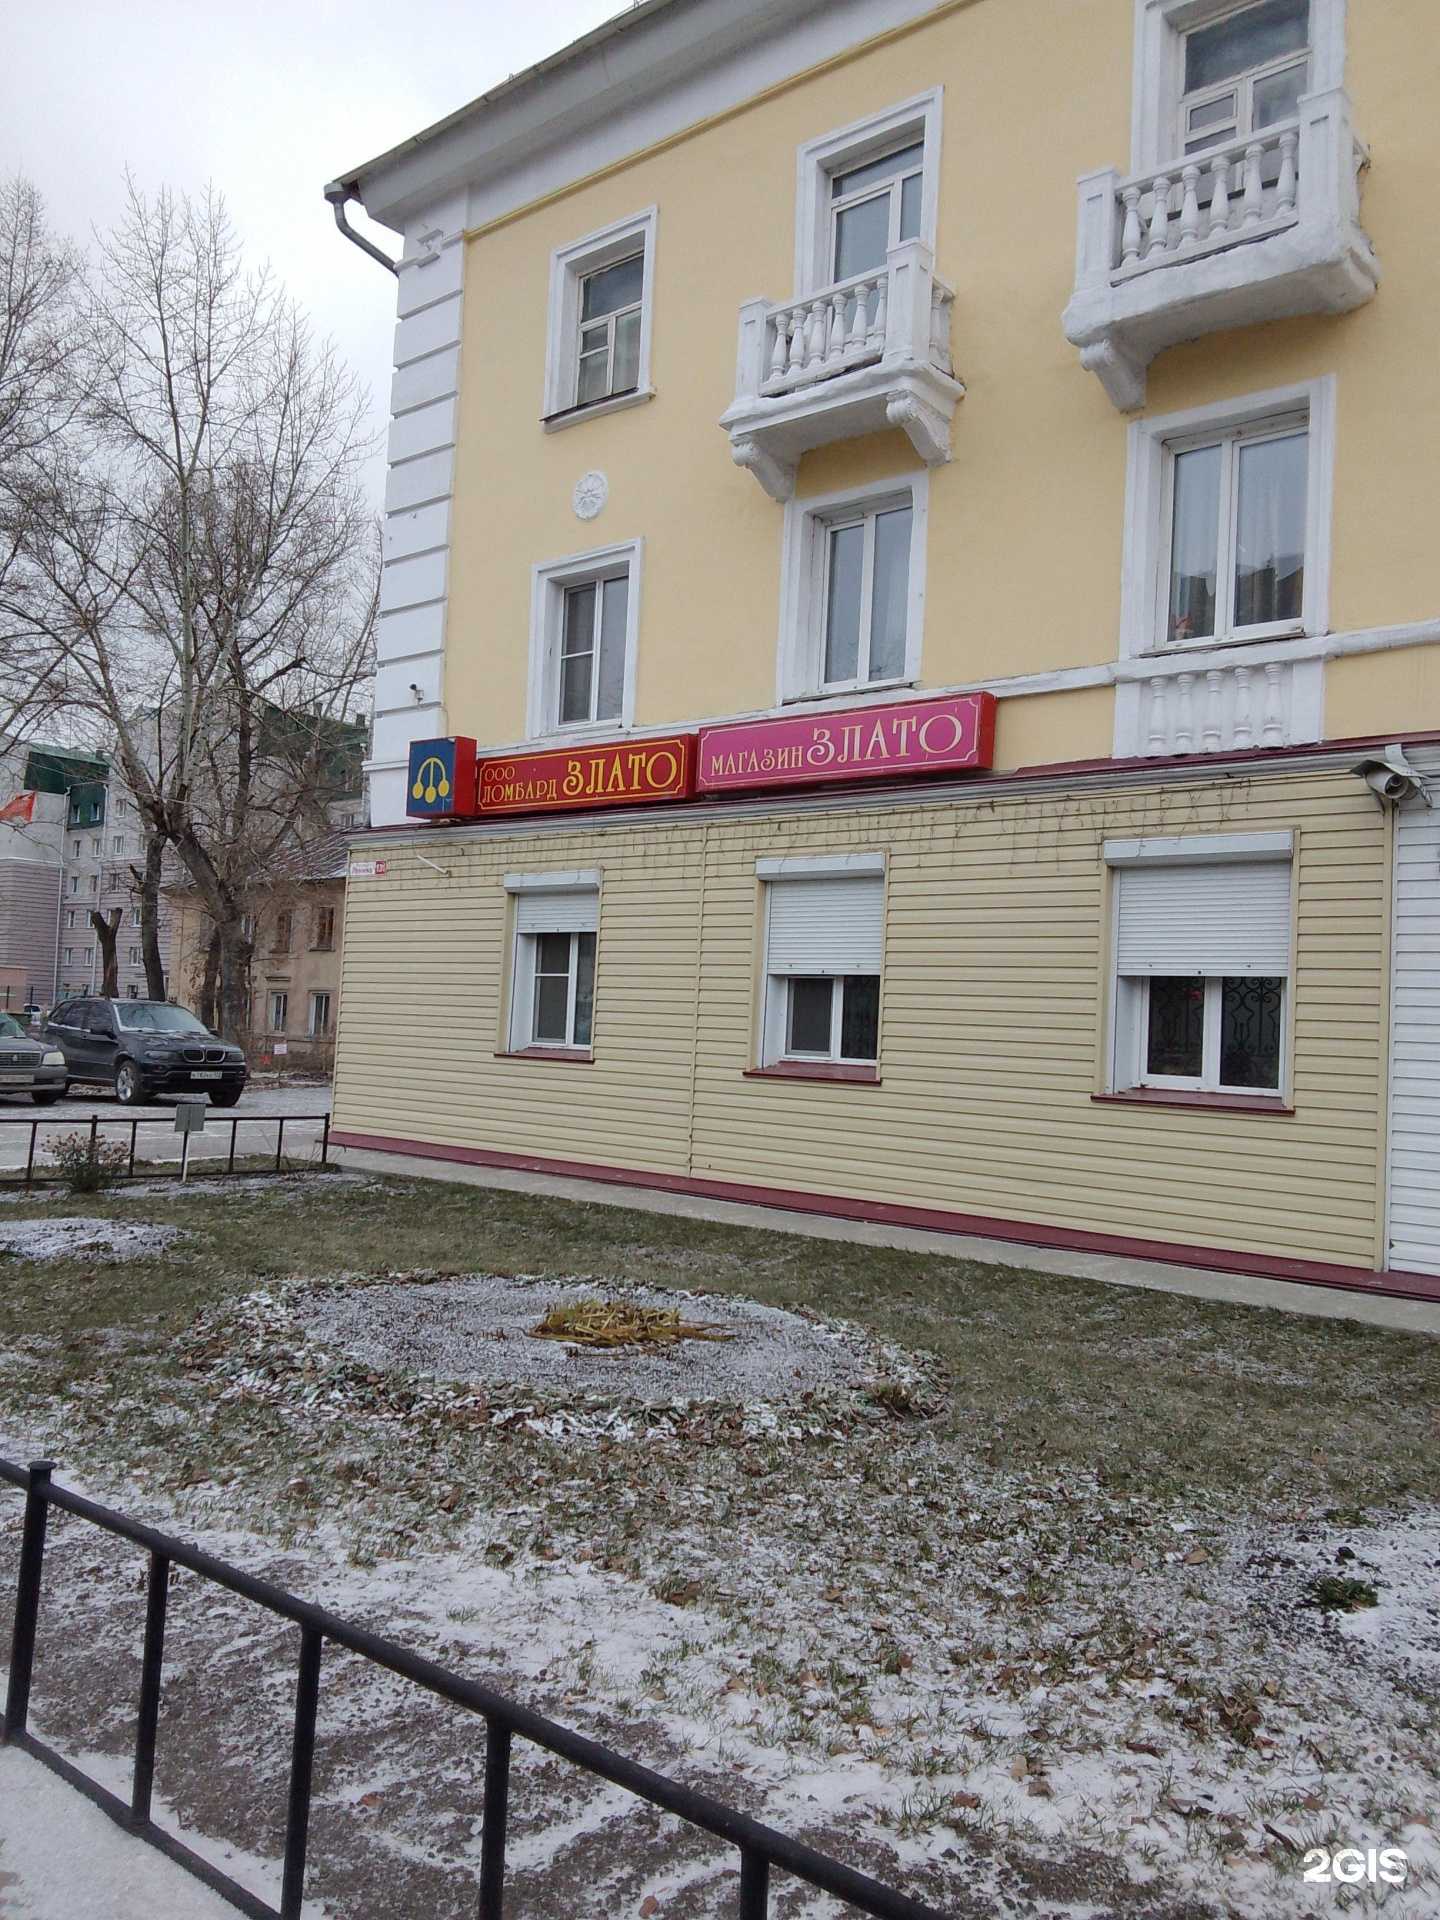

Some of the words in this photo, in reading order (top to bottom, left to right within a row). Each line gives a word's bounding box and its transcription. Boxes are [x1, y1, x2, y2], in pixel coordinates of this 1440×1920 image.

[710, 746, 803, 776] МАГАЗИН
[807, 714, 962, 766] ЗЛАТО
[482, 778, 558, 803] ЛОМБАРД
[562, 751, 678, 796] ЗЛАТО
[484, 766, 515, 783] ООО
